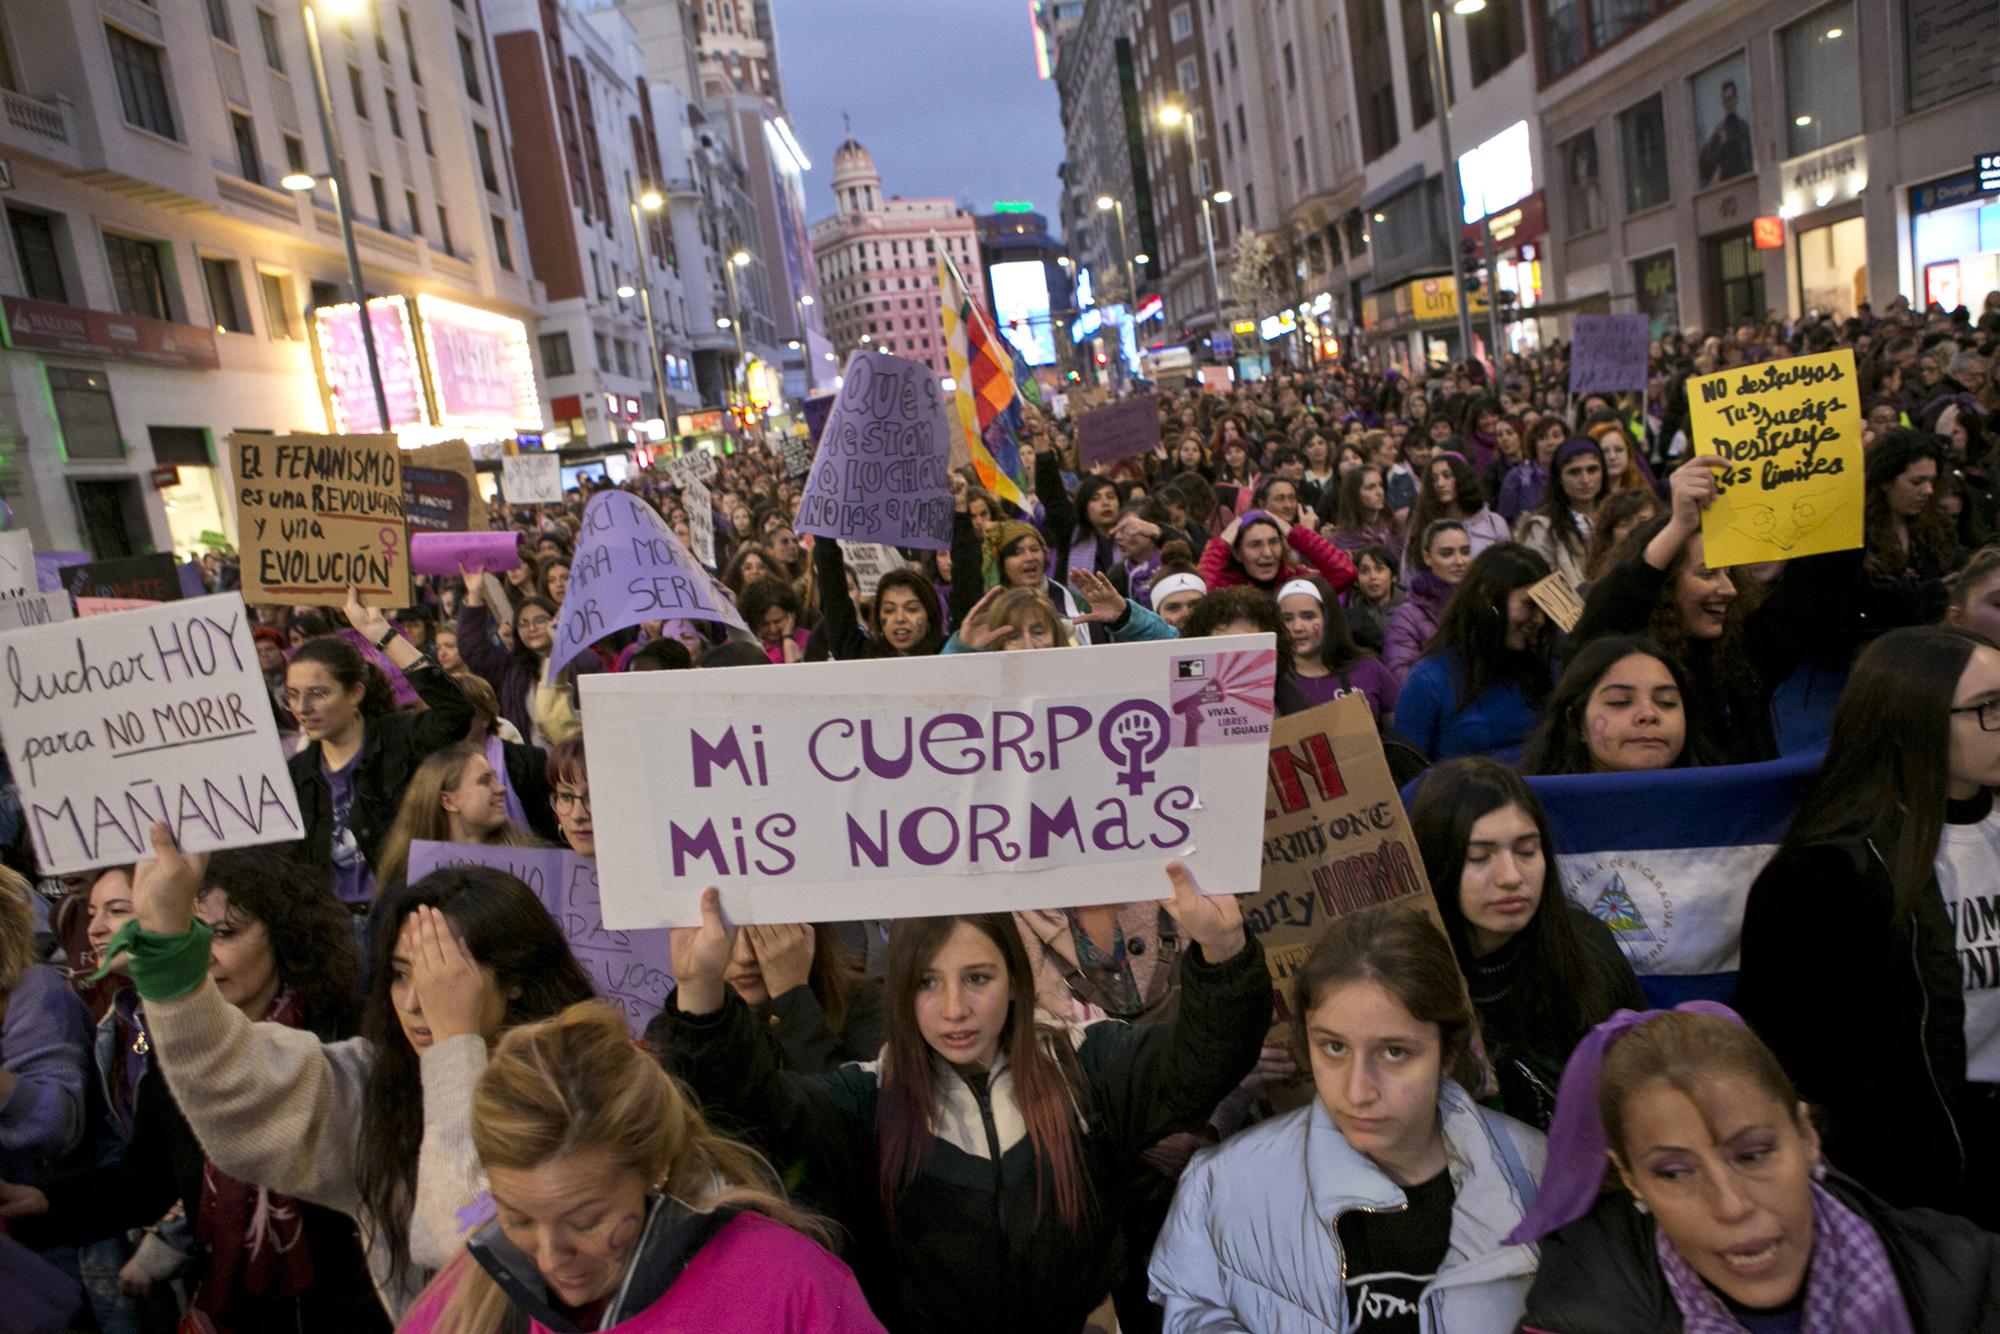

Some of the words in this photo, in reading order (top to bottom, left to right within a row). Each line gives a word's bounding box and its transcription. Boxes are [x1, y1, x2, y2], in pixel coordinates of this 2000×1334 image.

[1701, 378, 1728, 403] NO
[276, 445, 395, 487] FEMINISMO
[240, 487, 263, 507] es
[260, 545, 390, 588] EVOLUCIÓN
[7, 638, 154, 708] luchar
[149, 611, 244, 683] HOY
[20, 730, 95, 788] para
[102, 711, 146, 749] NO
[152, 692, 254, 743] MORIR
[1218, 716, 1249, 727] LIBRES
[1231, 724, 1269, 735] IGUALES
[31, 773, 299, 867] MAÑANA
[1247, 890, 1316, 936] arry
